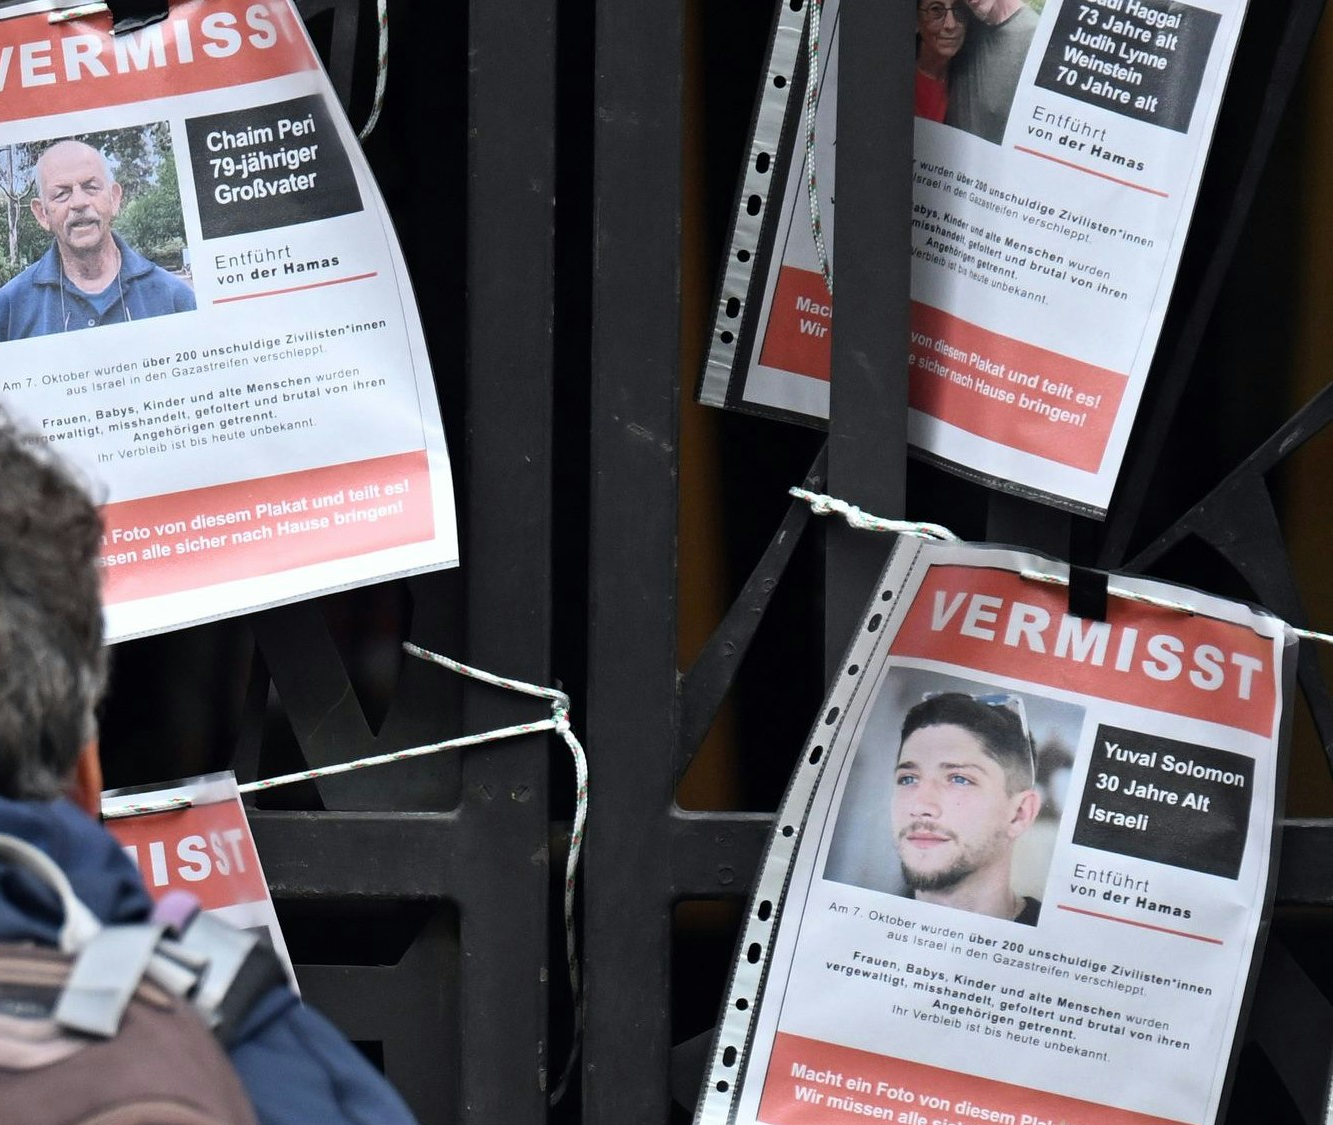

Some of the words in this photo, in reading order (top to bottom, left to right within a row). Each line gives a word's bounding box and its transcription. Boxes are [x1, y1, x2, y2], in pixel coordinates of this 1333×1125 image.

[1076, 4, 1100, 26] 73
[1100, 14, 1152, 43] Jahre
[1154, 30, 1178, 51] alt
[1123, 0, 1182, 29] Haggai
[1063, 44, 1143, 86] Weinstein
[1068, 26, 1116, 54] Judih
[1117, 40, 1168, 70] Lynne
[1055, 64, 1078, 86] 70
[1079, 74, 1131, 104] Jahre
[1133, 94, 1158, 113] alt
[205, 125, 274, 152] Chaim
[276, 112, 316, 140] Peri
[208, 143, 319, 179] 79-jähriger
[213, 171, 317, 205] Großvater
[96, 452, 114, 463] Ihr
[116, 441, 167, 459] Verbleib
[170, 438, 186, 450] ist
[188, 436, 208, 447] bis
[210, 429, 246, 443] heute
[248, 416, 318, 437] unbekannt.
[930, 591, 1264, 699] VERMISST
[1103, 740, 1158, 768] Yuval
[1159, 753, 1245, 788] Solomon
[1094, 771, 1120, 792] 30
[1122, 778, 1179, 805] Jahre
[1179, 791, 1211, 813] Alt
[1087, 802, 1149, 831] Israeli
